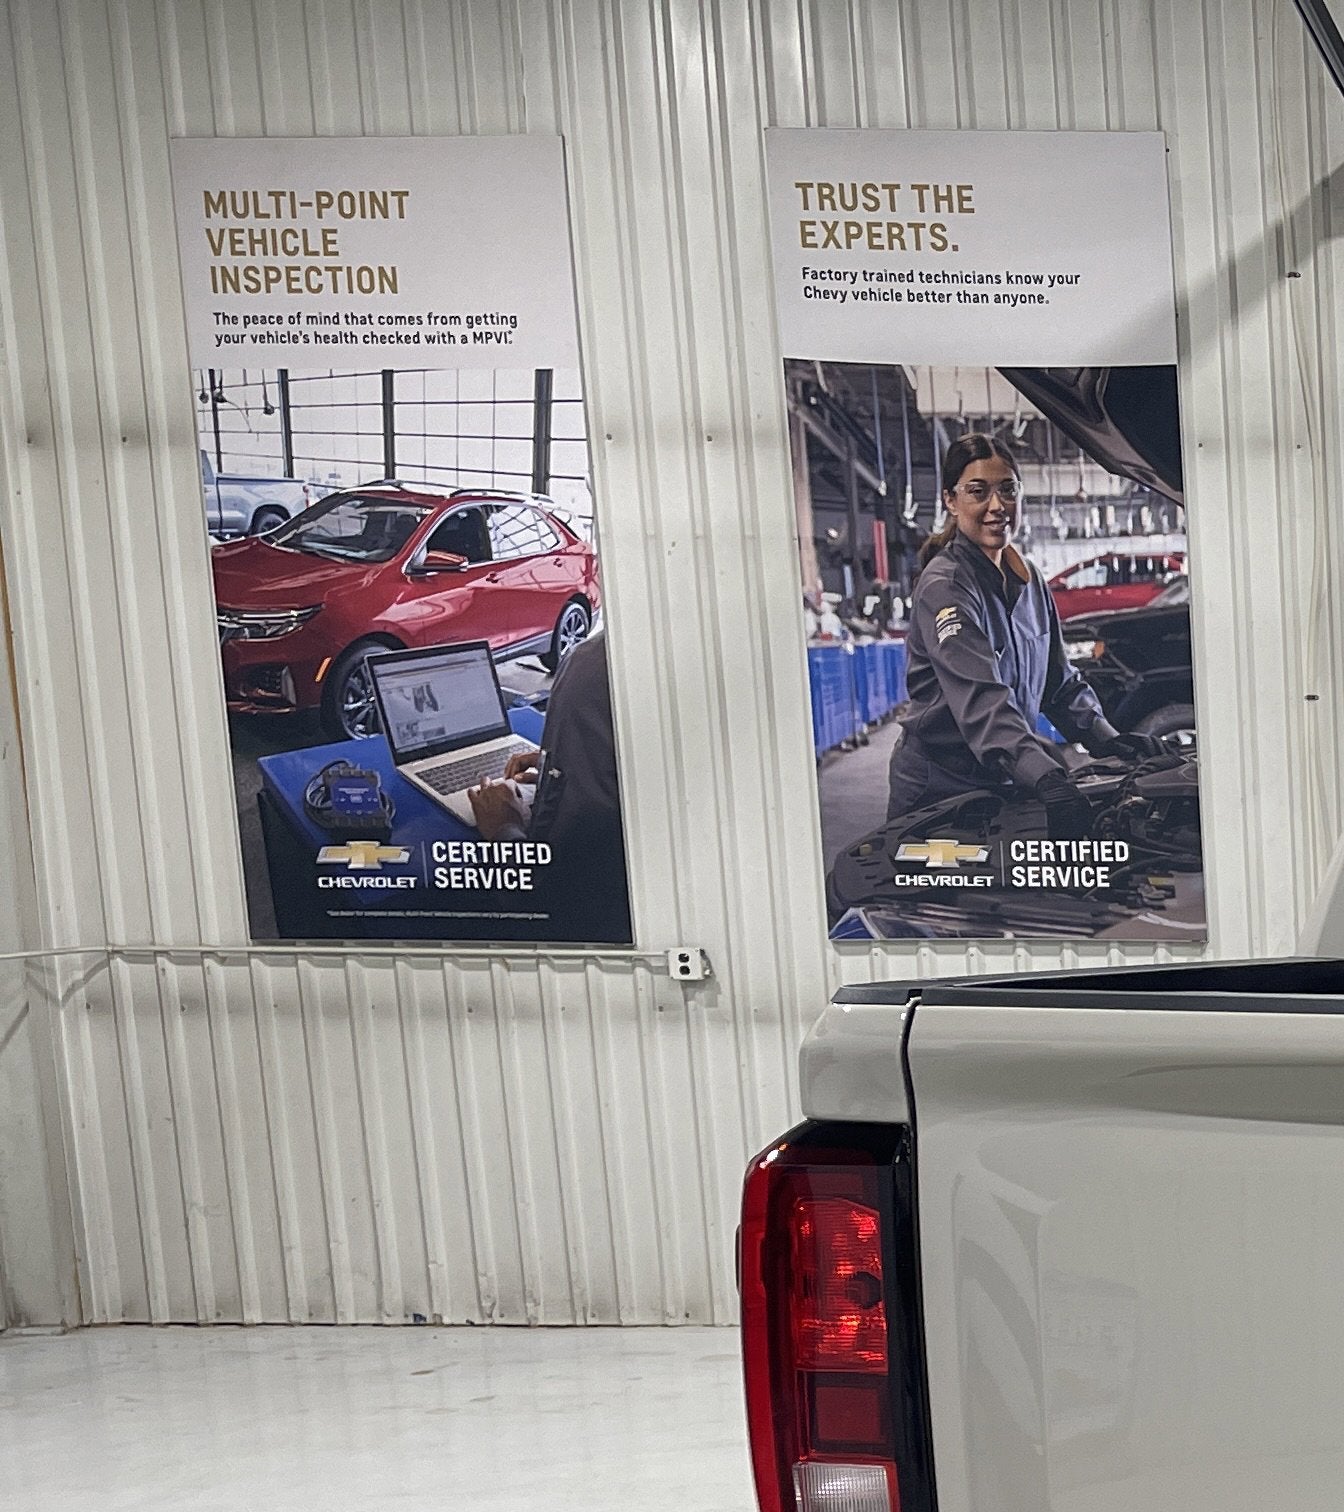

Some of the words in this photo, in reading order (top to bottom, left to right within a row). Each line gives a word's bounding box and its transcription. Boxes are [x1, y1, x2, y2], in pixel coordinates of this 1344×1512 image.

[203, 190, 409, 219] MULTI-POINT
[794, 182, 901, 213] TRUST
[911, 184, 975, 214] THE
[205, 228, 340, 257] VEHICLE
[799, 220, 959, 252] EXPERTS.
[210, 265, 399, 294] INSPECTION
[801, 266, 858, 285] Factory
[862, 268, 915, 284] trained
[918, 269, 1002, 285] technicians
[1005, 270, 1044, 286] know
[1047, 273, 1081, 289] your
[803, 286, 848, 304] Chevy
[851, 288, 903, 303] vehicle
[907, 289, 952, 303] better
[956, 290, 989, 305] than
[993, 292, 1050, 308] anyone.
[213, 312, 239, 326] The
[243, 314, 284, 329] peace
[287, 312, 302, 326] of
[306, 312, 340, 326] mind
[344, 312, 374, 326] that
[378, 314, 423, 326] comes
[427, 312, 461, 326] from
[465, 313, 518, 329] getting
[215, 333, 247, 347] your
[250, 330, 310, 345] vehicle's
[314, 330, 358, 345] health
[362, 331, 420, 345] checked
[424, 331, 456, 345] with
[460, 333, 468, 345] a
[431, 841, 552, 865] CERTIFIED
[1010, 840, 1129, 863] CERTIFIED
[317, 876, 418, 889] CHEVROLET
[434, 868, 534, 891] SERVICE
[895, 874, 995, 888] CHEVROLET
[1011, 866, 1111, 888] SERVICE
